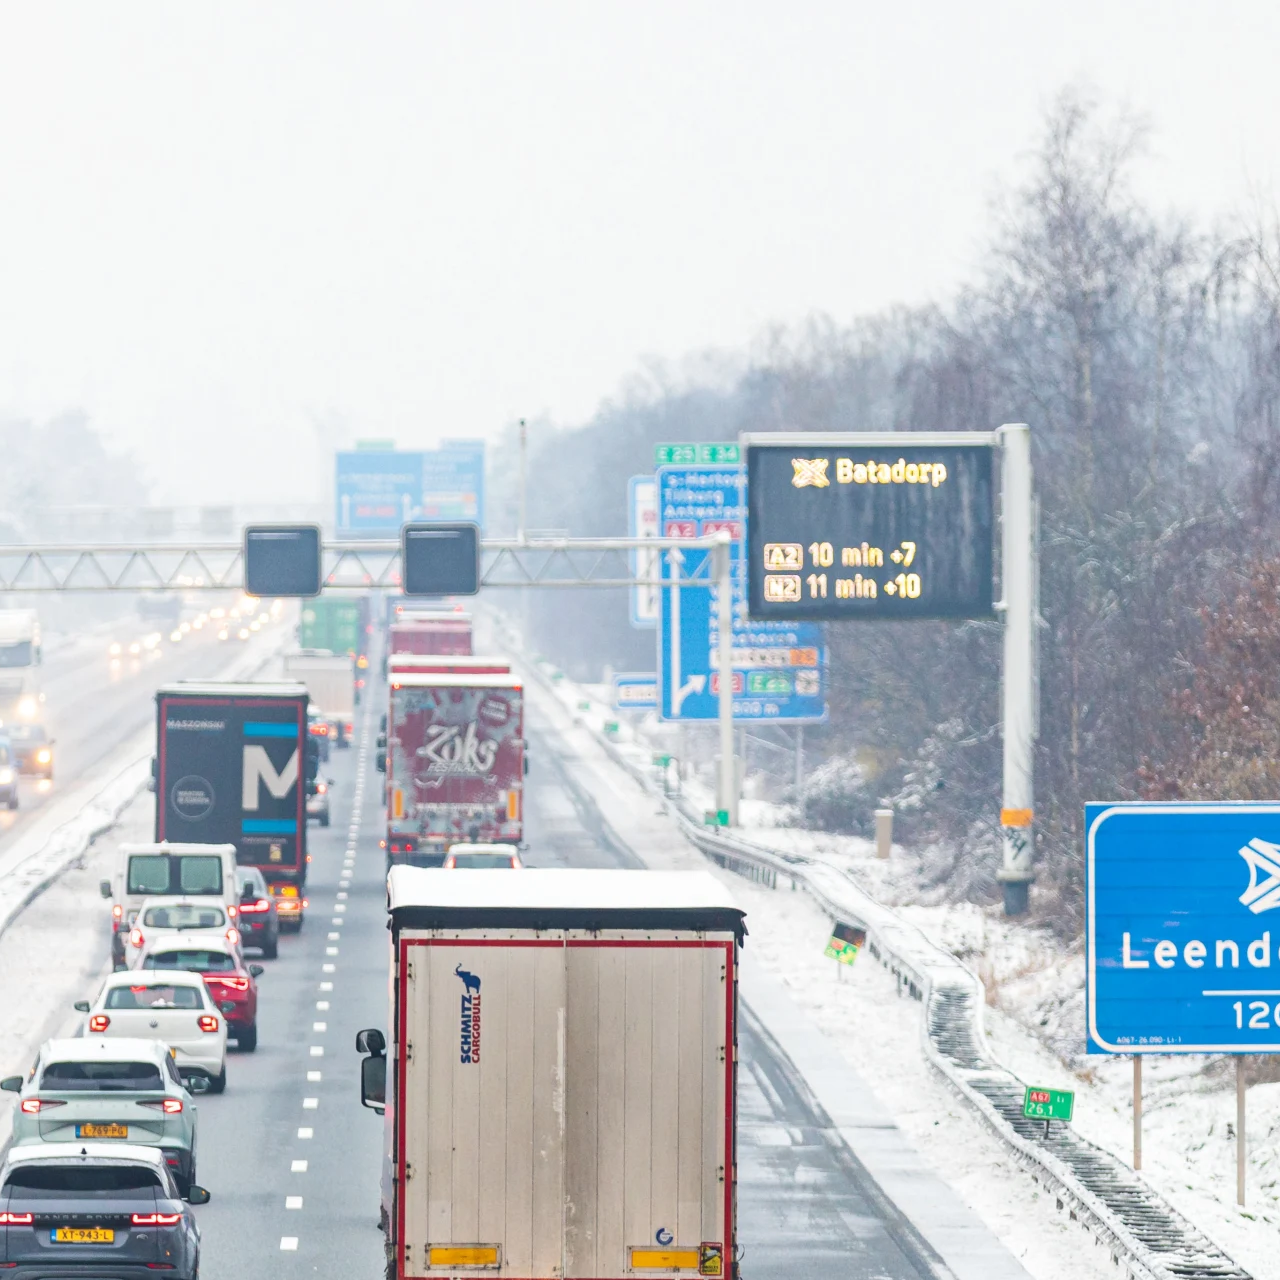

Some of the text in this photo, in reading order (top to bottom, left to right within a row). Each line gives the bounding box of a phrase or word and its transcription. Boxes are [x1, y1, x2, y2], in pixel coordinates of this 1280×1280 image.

[659, 446, 693, 459] E 25
[701, 446, 737, 459] E 34
[836, 458, 947, 487] Batadorp
[770, 542, 916, 567] A2 10 min +7
[769, 577, 796, 597] N2
[806, 574, 827, 598] 11
[835, 574, 877, 598] min
[884, 574, 921, 598] +10
[242, 744, 300, 811] M
[461, 995, 472, 1064] SCHMITZ
[472, 994, 481, 1064] CARGOBULL
[1031, 1092, 1050, 1101] A67
[62, 1230, 109, 1240] XT-943-L
